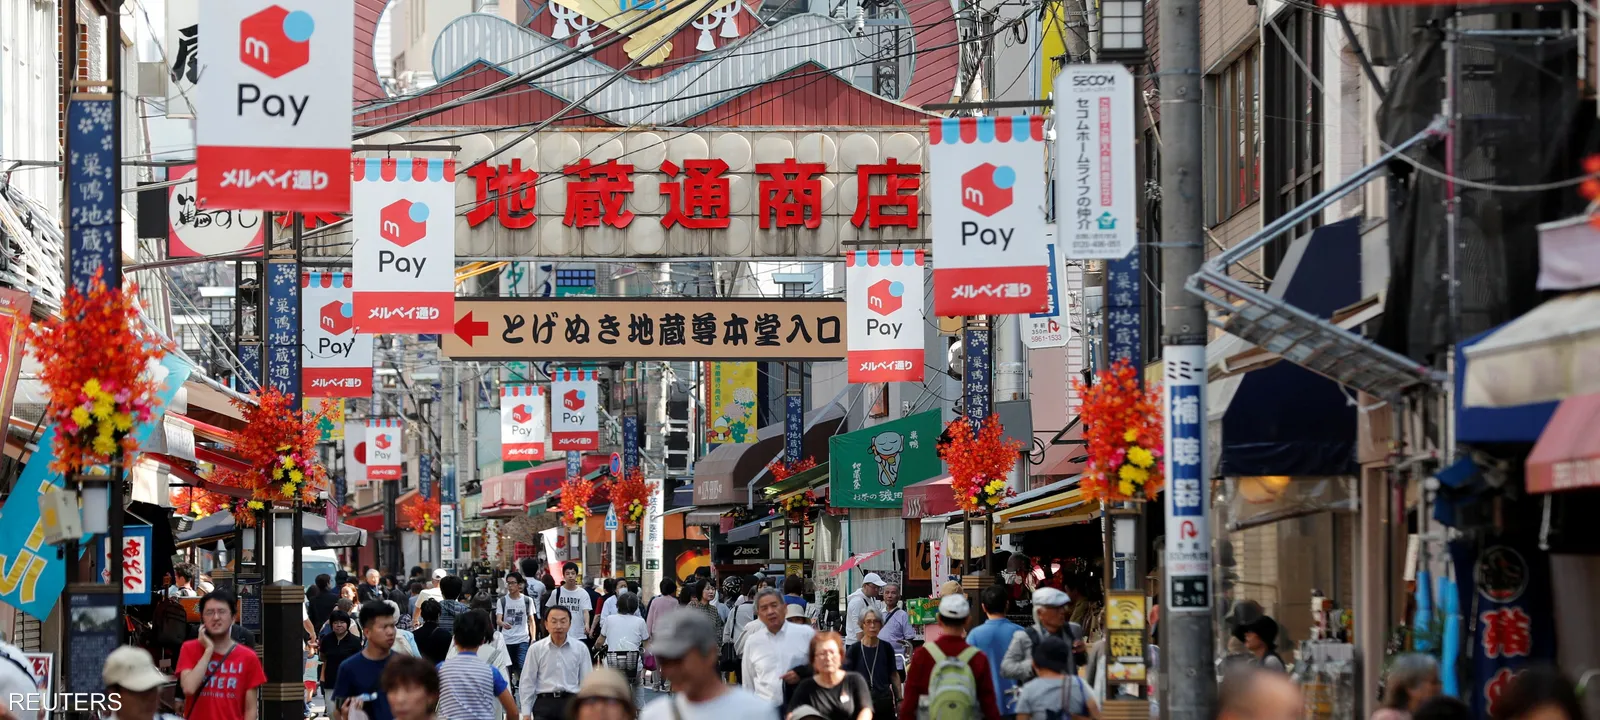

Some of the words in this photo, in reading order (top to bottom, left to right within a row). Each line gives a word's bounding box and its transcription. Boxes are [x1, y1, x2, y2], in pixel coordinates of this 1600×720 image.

[1072, 75, 1115, 86] SECOM
[237, 83, 309, 126] Pay
[1076, 98, 1092, 230] セコムホームライフの仲介
[219, 168, 329, 190] メルペイ通り
[961, 221, 1015, 251] Pay
[379, 250, 427, 278] Pay
[951, 283, 1032, 299] メルペイ通り
[368, 306, 439, 320] メルペイ通り
[501, 312, 842, 346] とげぬき地蔵尊本堂入口
[867, 319, 903, 339] Pay
[274, 298, 290, 396] 巣鴨地蔵通り
[319, 337, 354, 358] Pay
[860, 360, 913, 371] メルペイ通り
[311, 378, 362, 388] メルペイ通り
[971, 356, 984, 431] 巣鴨地蔵通り
[563, 412, 585, 425] Pay
[511, 425, 532, 436] Pay
[909, 430, 919, 449] 巣鴨
[375, 451, 391, 460] Pay
[1172, 395, 1201, 507] 補聴器
[207, 661, 243, 674] OLLI
